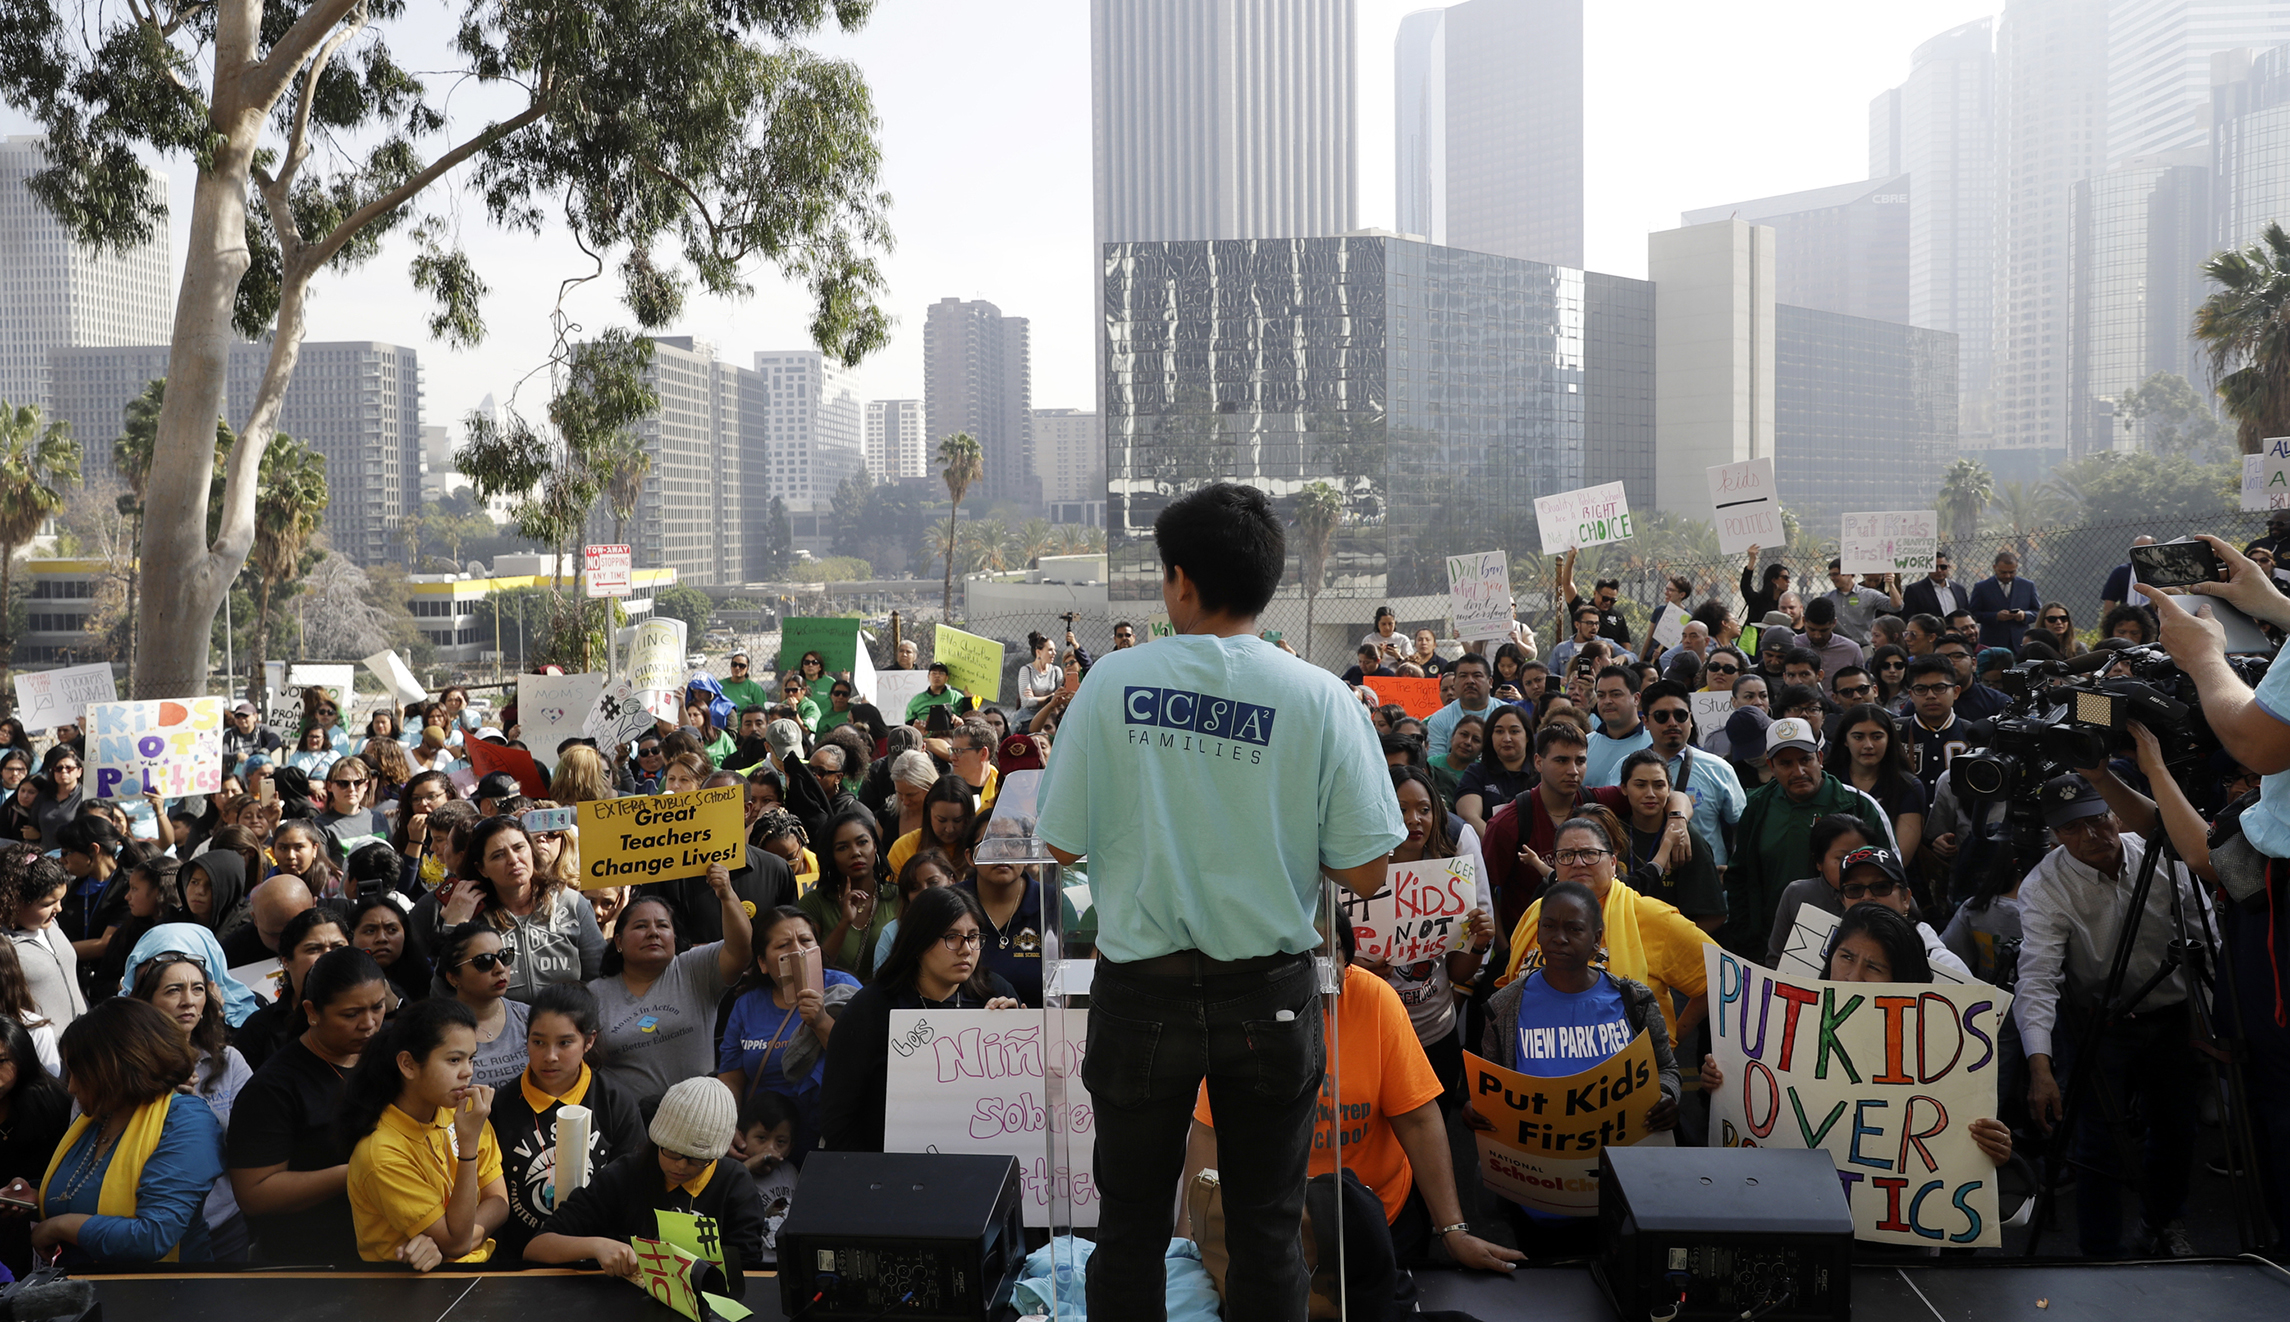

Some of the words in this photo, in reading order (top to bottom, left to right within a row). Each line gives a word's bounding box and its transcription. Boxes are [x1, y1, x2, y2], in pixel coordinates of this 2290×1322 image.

[1872, 194, 1908, 204] CBRE
[1716, 465, 1760, 493] kids
[2268, 471, 2287, 487] A
[1540, 498, 1573, 514] Quality
[1601, 486, 1624, 502] Schools
[1582, 502, 1617, 519] RIGHT
[1579, 514, 1632, 542] CHOICE
[1724, 511, 1773, 537] POLITICS
[1845, 516, 1878, 537] Put
[1884, 514, 1930, 537] Kids
[587, 546, 628, 554] TOW-AWAY
[1843, 539, 1894, 562] First!
[587, 555, 600, 570] NO
[601, 557, 629, 567] STOPPING
[1481, 555, 1504, 578] ban
[1894, 556, 1934, 569] WORK
[592, 572, 606, 580] ANY
[611, 571, 626, 579] TIME
[1452, 578, 1480, 601] what
[1482, 580, 1503, 599] you
[1456, 604, 1512, 621] understand
[60, 674, 104, 689] SCHOOLS!
[877, 674, 916, 690] KIDS
[1370, 680, 1386, 692] Do
[1392, 681, 1411, 692] The
[1414, 682, 1437, 700] Right
[62, 683, 112, 704] CHARTER
[293, 701, 301, 709] A
[535, 688, 584, 699] MOMS
[1411, 697, 1436, 709] Vote
[99, 732, 196, 763] NOT
[1129, 729, 1261, 765] FAMILIES
[594, 800, 647, 820] EXTERA
[696, 788, 736, 806] SCHOOLS
[635, 806, 697, 826] Great
[620, 828, 712, 851] Teachers
[591, 856, 674, 877] Change
[682, 843, 737, 867] Lives!
[1448, 858, 1475, 880] ICEF
[1395, 916, 1454, 945] NOT
[540, 957, 571, 971] DIV.
[652, 1004, 681, 1016] Action
[621, 1040, 651, 1053] Better
[653, 1026, 694, 1046] Education
[1520, 1027, 1555, 1059] VIEW
[1559, 1025, 1599, 1058] PARK
[1598, 1018, 1631, 1055] PREP
[490, 1050, 528, 1066] RIGHTS
[477, 1063, 526, 1080] OTHERS
[1479, 1070, 1548, 1115] Put
[1565, 1058, 1649, 1116] Kids
[969, 1092, 1094, 1139] Sobre
[1744, 1060, 1949, 1174] OVER
[513, 1122, 600, 1158] VISA
[1518, 1110, 1626, 1151] First!
[1489, 1150, 1544, 1173] NATIONAL
[510, 1180, 538, 1229] CHARTER
